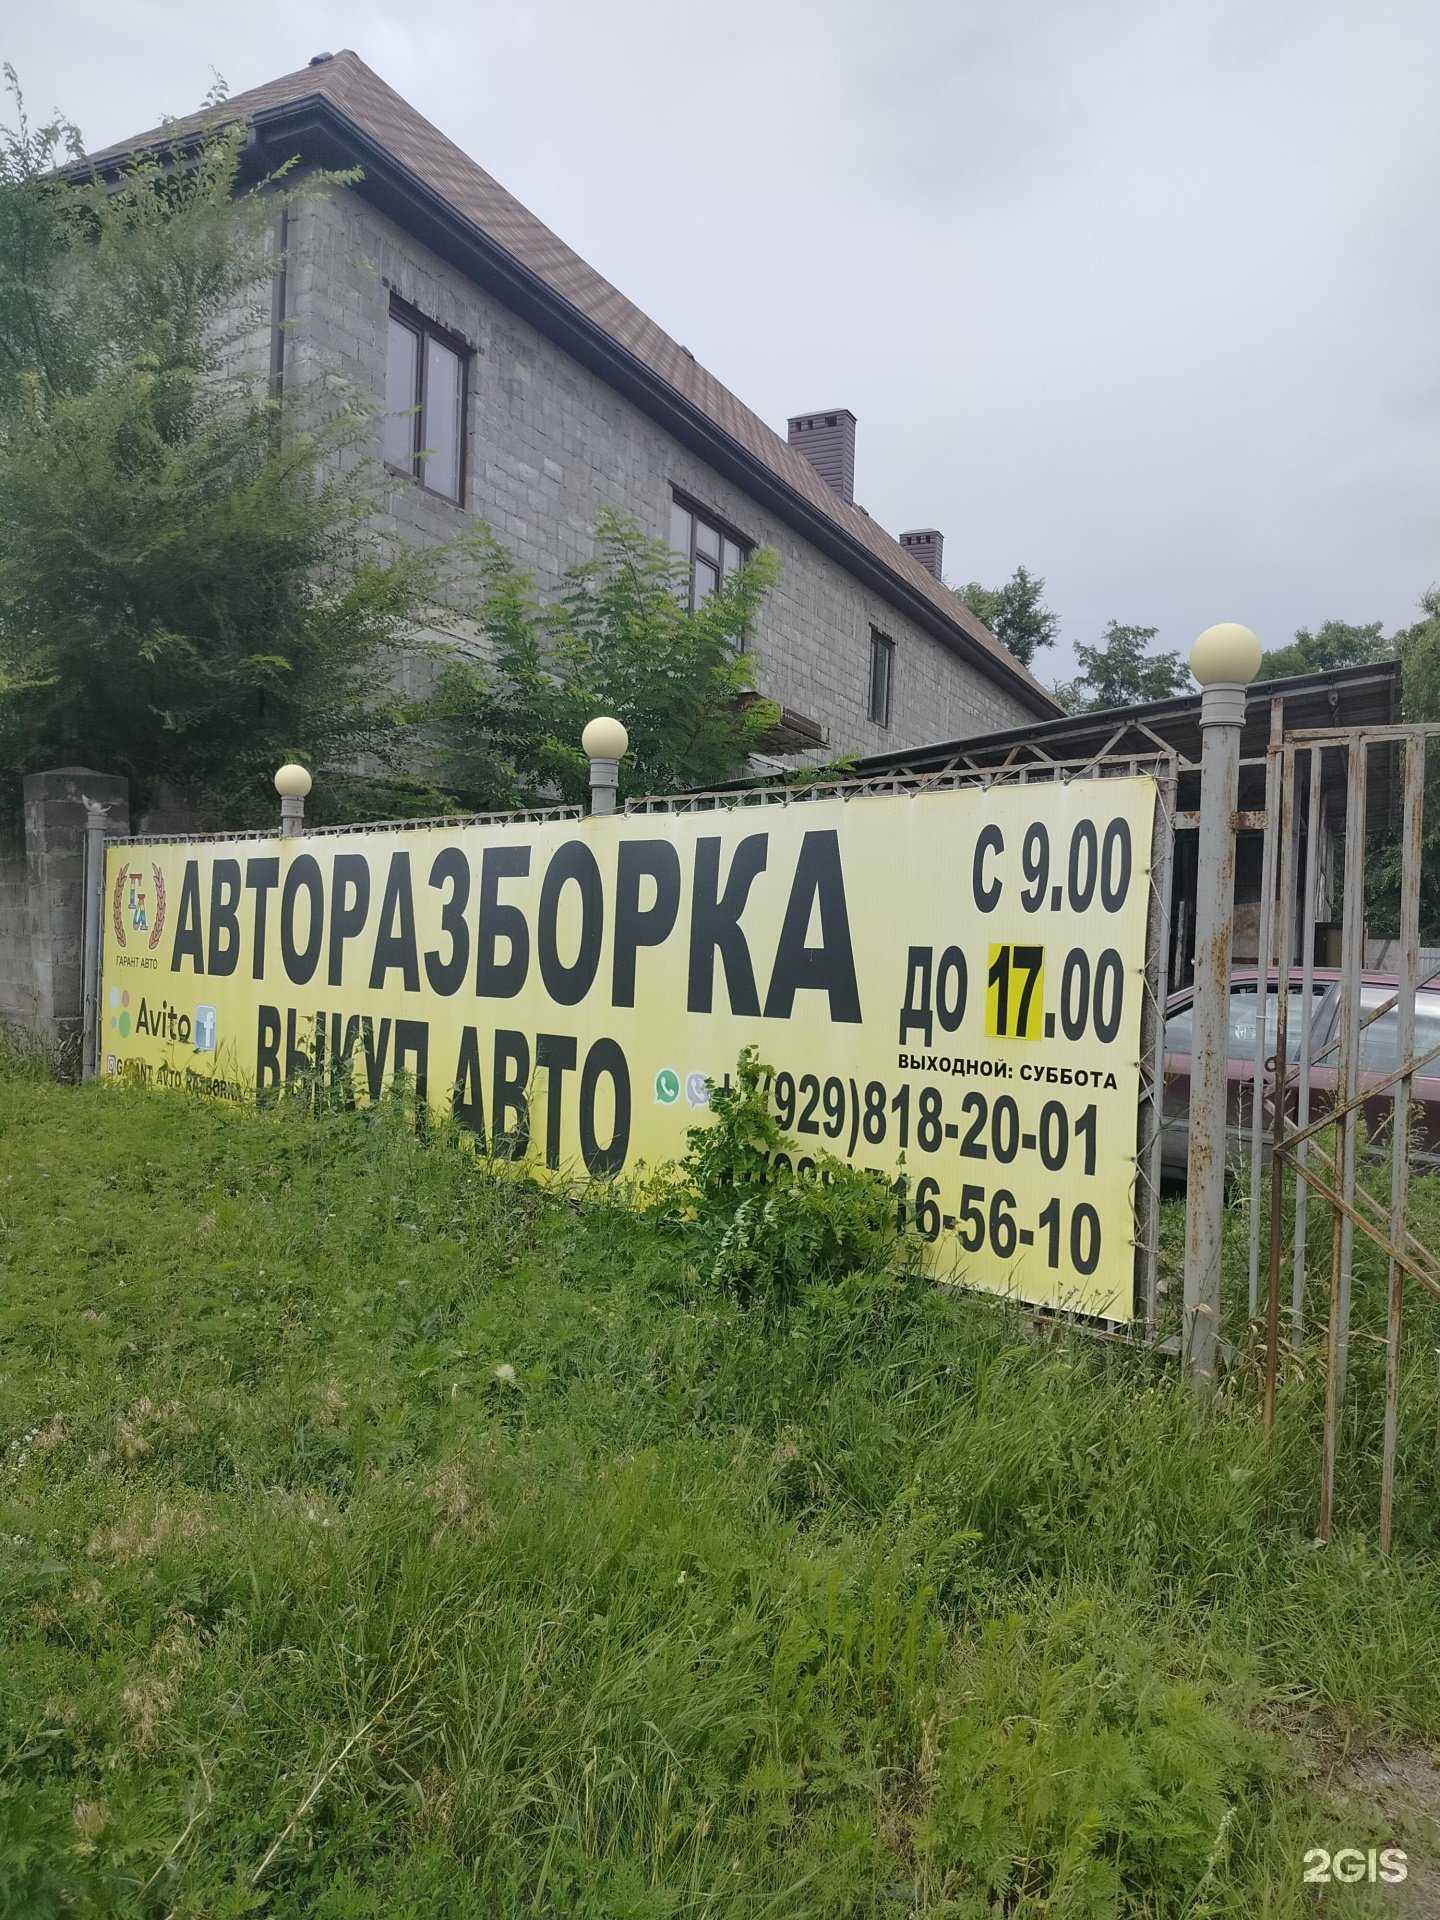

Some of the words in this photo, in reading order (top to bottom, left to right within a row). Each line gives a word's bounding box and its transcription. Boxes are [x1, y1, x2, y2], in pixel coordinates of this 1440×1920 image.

[972, 823, 1004, 913] С
[1020, 816, 1133, 914] 9.00
[115, 955, 139, 968] ГАРАНТ
[140, 957, 158, 969] АВТО
[171, 829, 863, 1024] АВТОРАЗБОРКА
[136, 997, 192, 1042] Avito
[899, 945, 968, 1047] ДО
[987, 945, 1125, 1044] 17.00
[453, 1025, 632, 1182] АВТО
[898, 1053, 1014, 1079] ВЫХОДНОЙ:
[1019, 1064, 1118, 1091] СУББОТА
